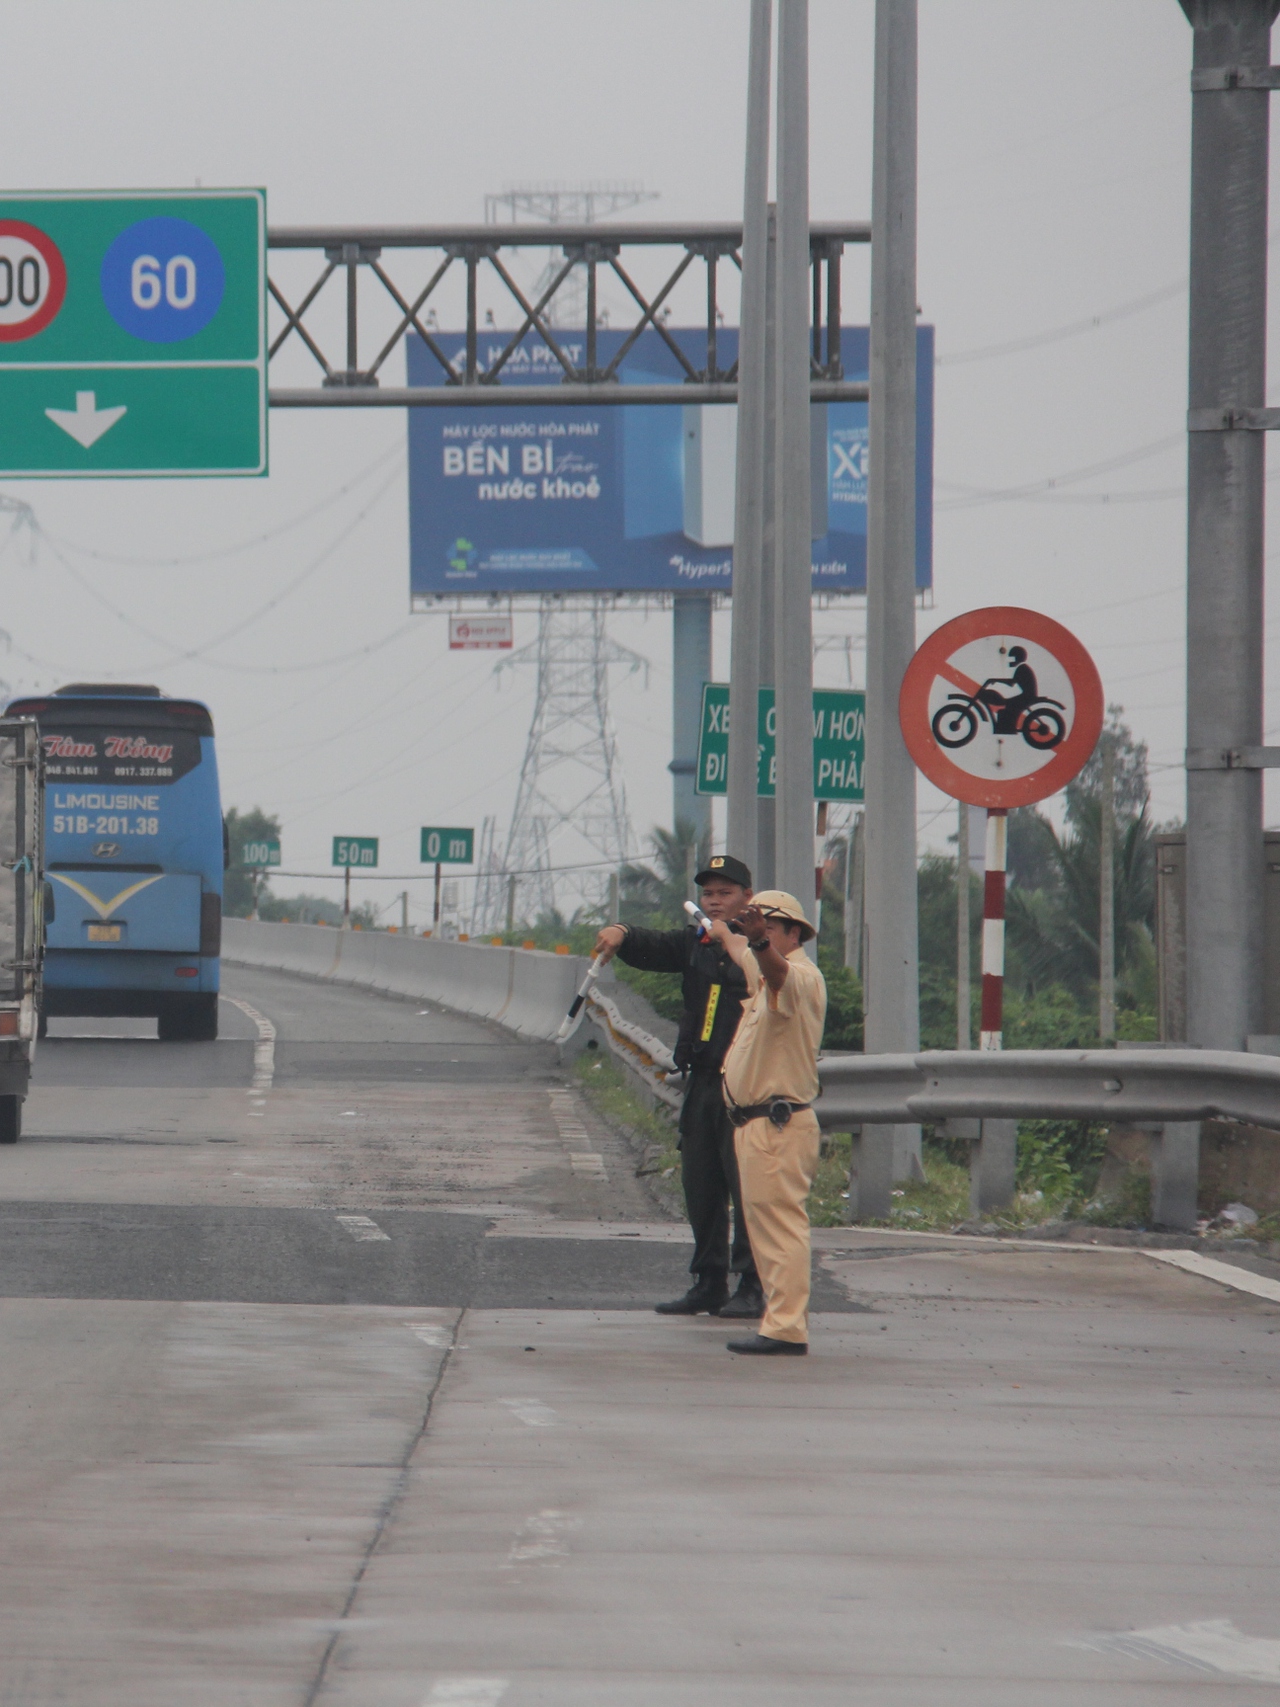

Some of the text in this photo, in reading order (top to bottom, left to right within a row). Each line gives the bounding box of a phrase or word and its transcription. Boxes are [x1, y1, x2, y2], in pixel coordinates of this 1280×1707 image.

[131, 255, 197, 310] 60
[478, 476, 538, 500] nước
[705, 752, 727, 782] ĐI
[54, 793, 160, 811] LIMOUSINE
[53, 815, 159, 836] 51B-201.38
